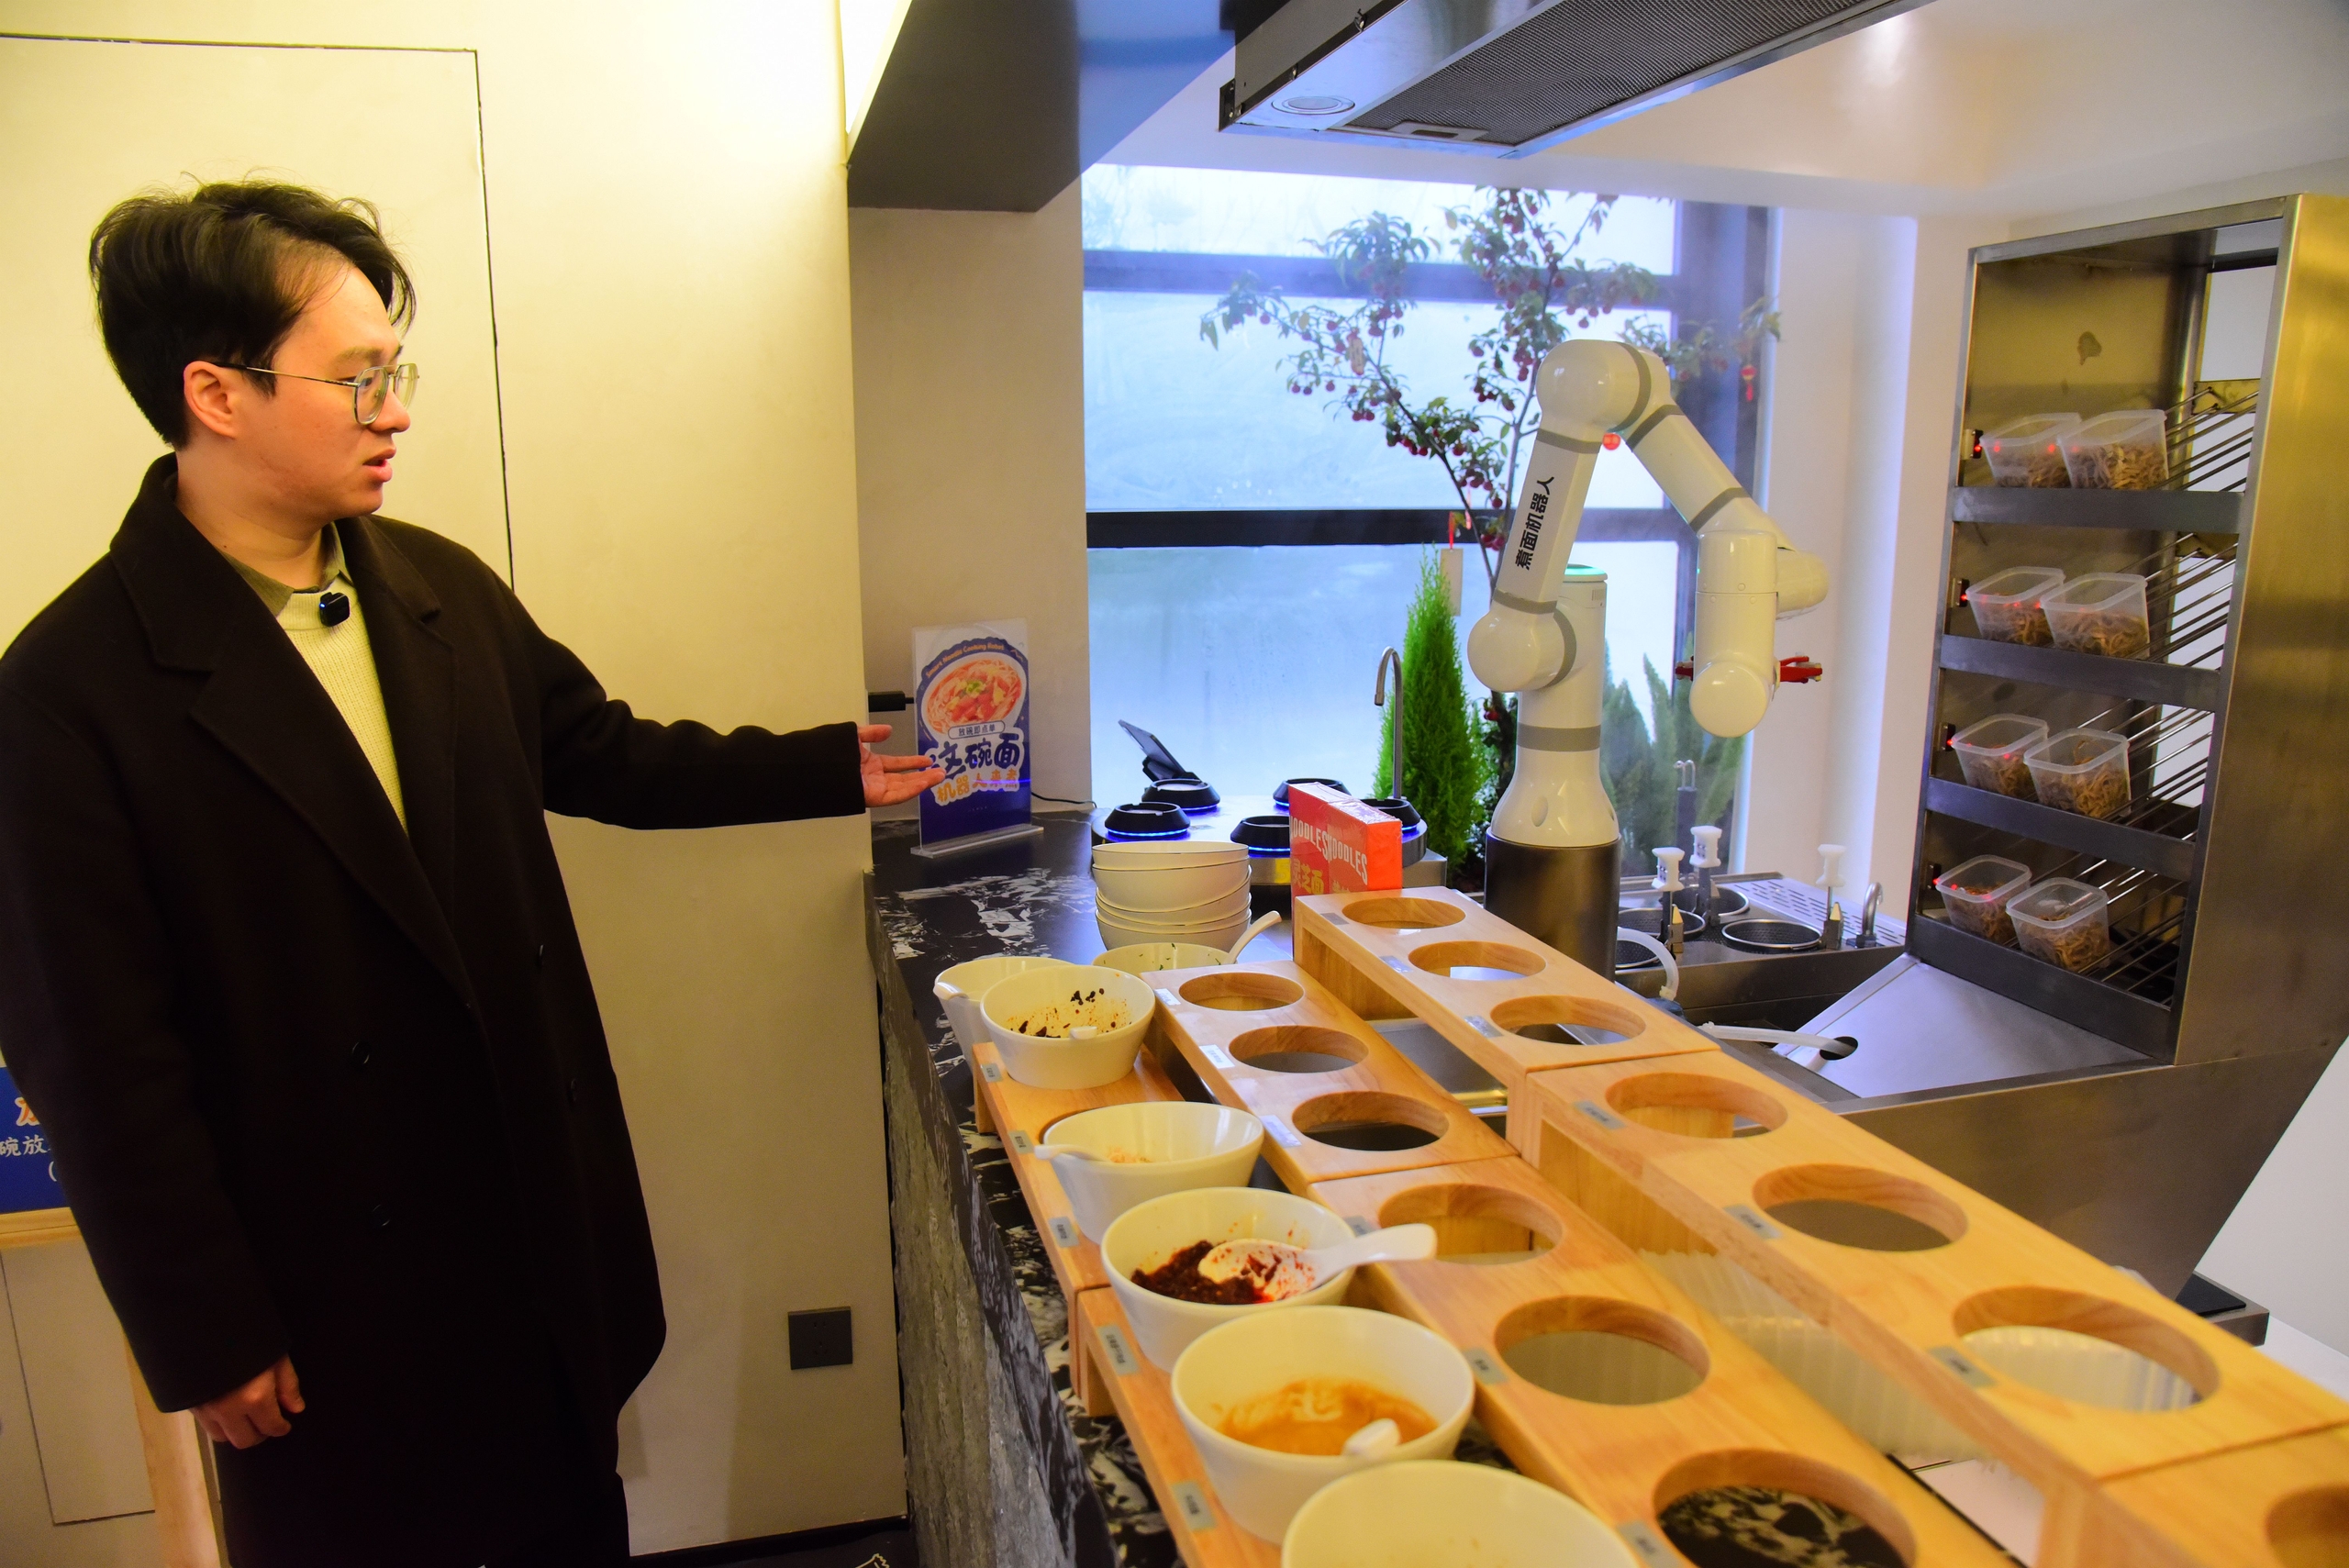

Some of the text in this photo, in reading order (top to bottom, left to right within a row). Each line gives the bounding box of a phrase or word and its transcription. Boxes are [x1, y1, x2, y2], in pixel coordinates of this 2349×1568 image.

[1515, 476, 1554, 571] 煮面机器人
[958, 724, 996, 736] 放碗即点单
[937, 768, 1018, 802] 机器人来煮
[1327, 834, 1367, 885] NOODLES
[0, 1134, 51, 1158] 碗放
